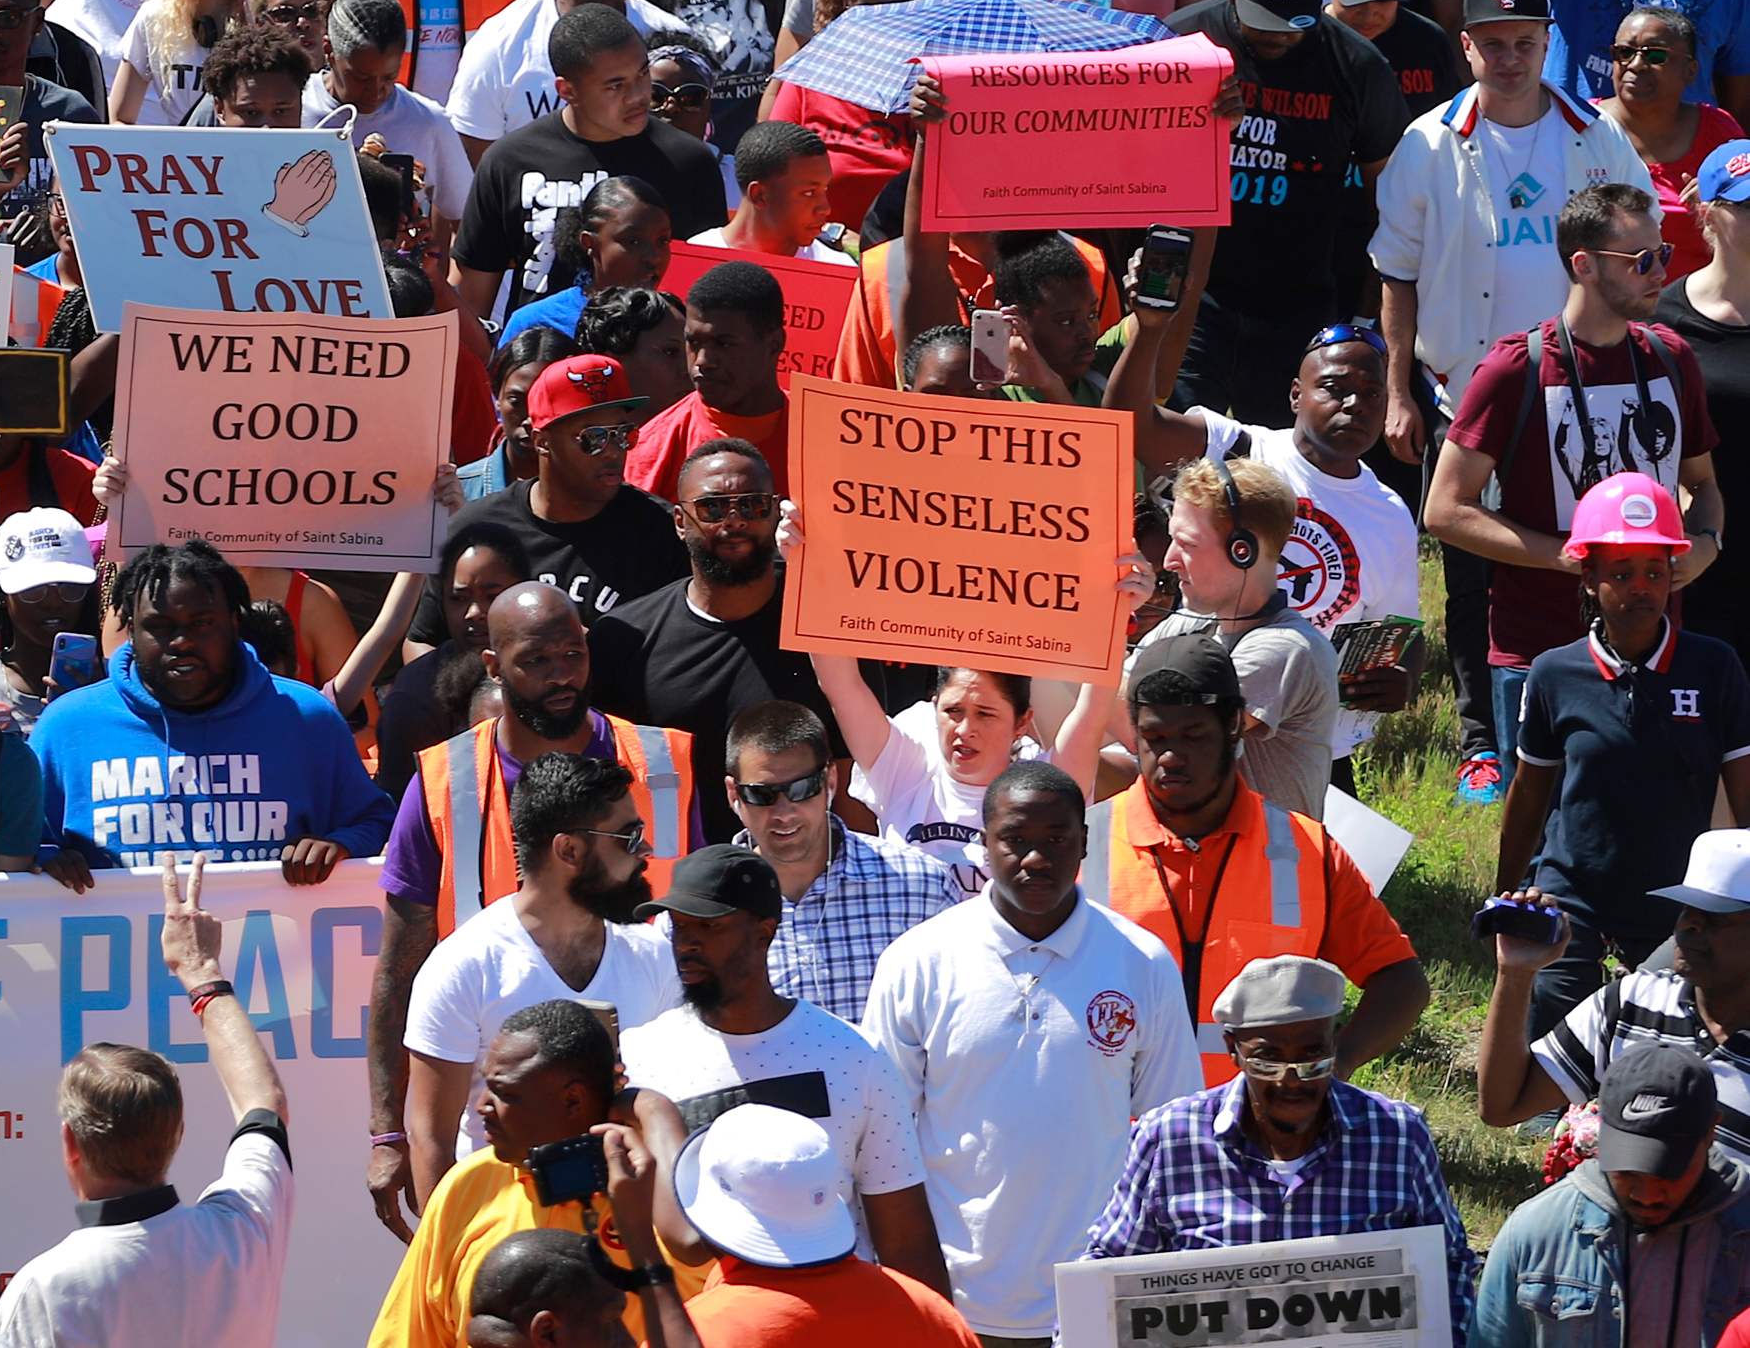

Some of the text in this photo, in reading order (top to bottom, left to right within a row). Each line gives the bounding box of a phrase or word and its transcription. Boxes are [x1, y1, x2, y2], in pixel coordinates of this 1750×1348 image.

[970, 61, 1192, 88] RESOURCES FOR
[949, 106, 1208, 137] OUR COMMUNITIES
[1262, 88, 1332, 120] WILSON
[1237, 116, 1277, 145] FOR
[982, 181, 1168, 200] Faith Community of Saint Sabina
[169, 333, 411, 379] WE NEED
[213, 404, 358, 442] GOOD
[840, 409, 1082, 468] STOP THIS
[163, 469, 397, 506] SCHOOLS
[833, 481, 1091, 542] SENSELESS
[168, 527, 383, 545] Faith Community of Saint Sabina
[845, 549, 1081, 611] VIOLENCE
[1320, 542, 1342, 580] FIRED
[839, 615, 1071, 654] Faith Community of Saint Sabina
[92, 754, 260, 802] MARCH
[94, 802, 287, 846] FOR OUR
[1142, 1256, 1375, 1290] THINGS HAVE GOT TO CHANGE
[1131, 1287, 1401, 1339] PUT DOWN
